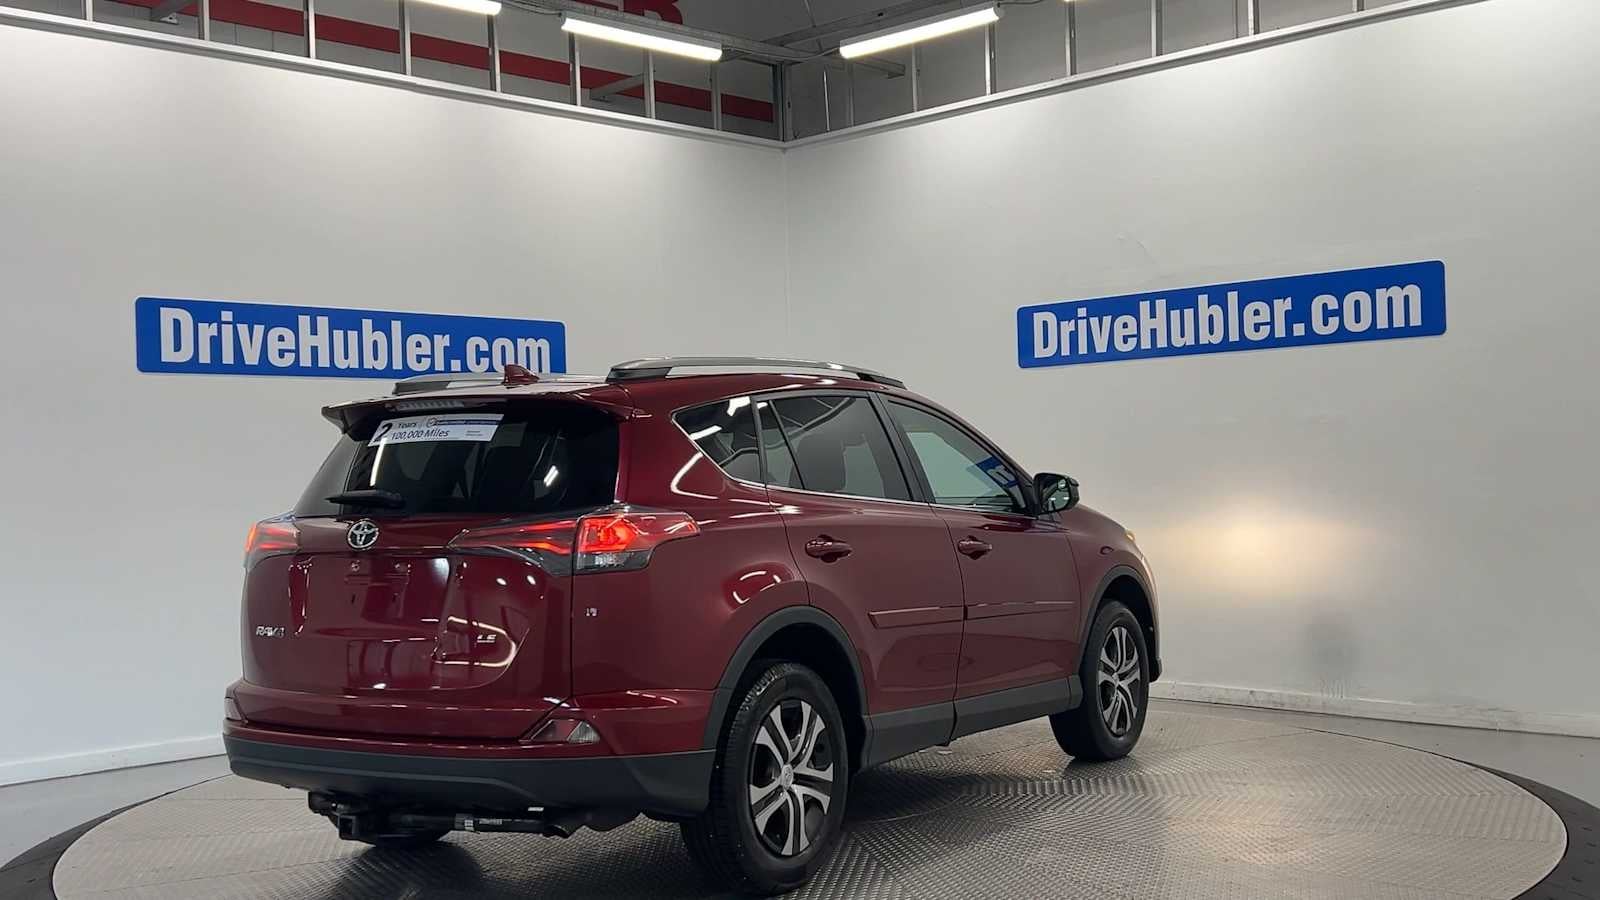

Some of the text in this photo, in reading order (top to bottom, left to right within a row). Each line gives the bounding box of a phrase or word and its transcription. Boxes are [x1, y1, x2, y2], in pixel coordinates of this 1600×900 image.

[158, 306, 551, 374] DriveHubler.com
[1032, 283, 1422, 359] DriveHubler.com
[424, 428, 450, 438] Miles
